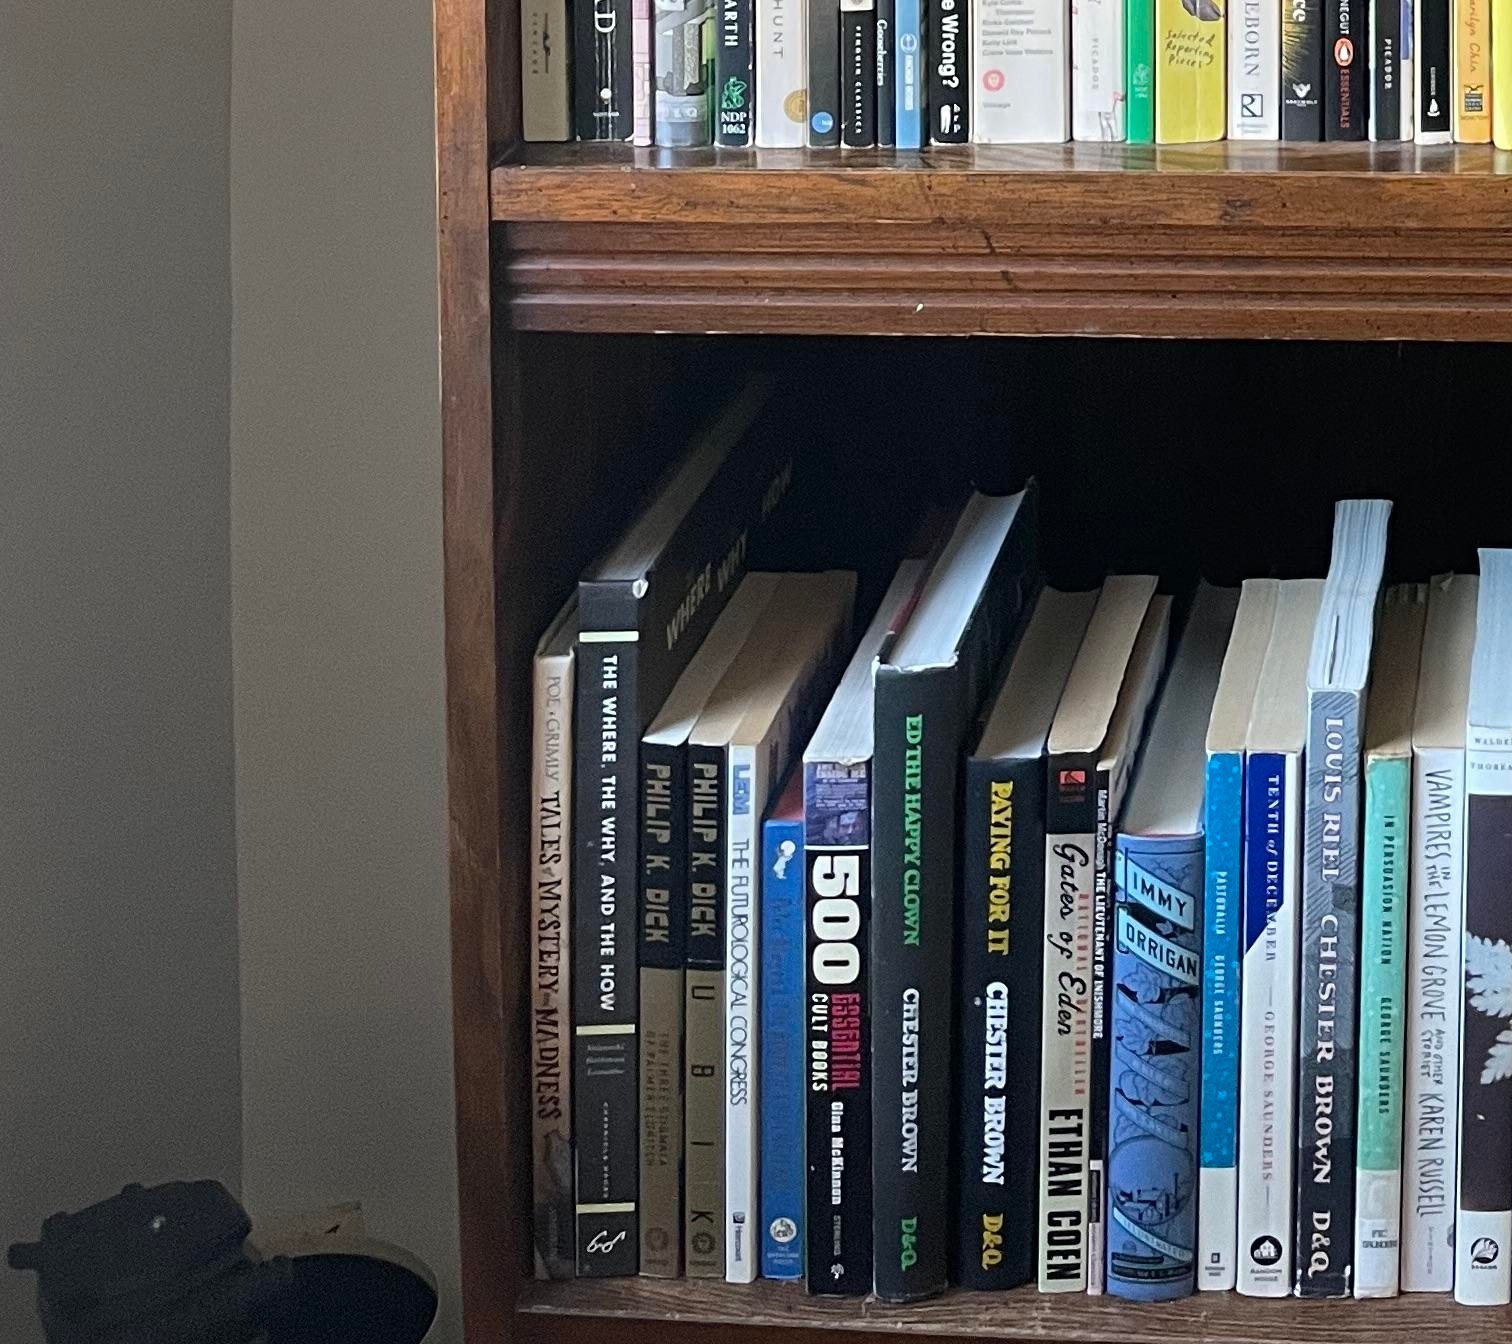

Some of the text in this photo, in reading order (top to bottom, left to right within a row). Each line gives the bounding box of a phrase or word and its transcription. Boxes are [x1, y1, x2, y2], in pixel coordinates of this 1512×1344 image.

[937, 13, 960, 89] Wrong?
[600, 654, 619, 692] THE
[599, 695, 618, 769] WHERE,
[600, 775, 617, 811] THE
[599, 874, 616, 917] AND
[810, 855, 861, 985] 500
[599, 923, 616, 957] THE
[599, 962, 616, 1012] HOW
[810, 992, 830, 1092] CULT BOOKS
[1046, 1108, 1085, 1282] ETHAN COEN
